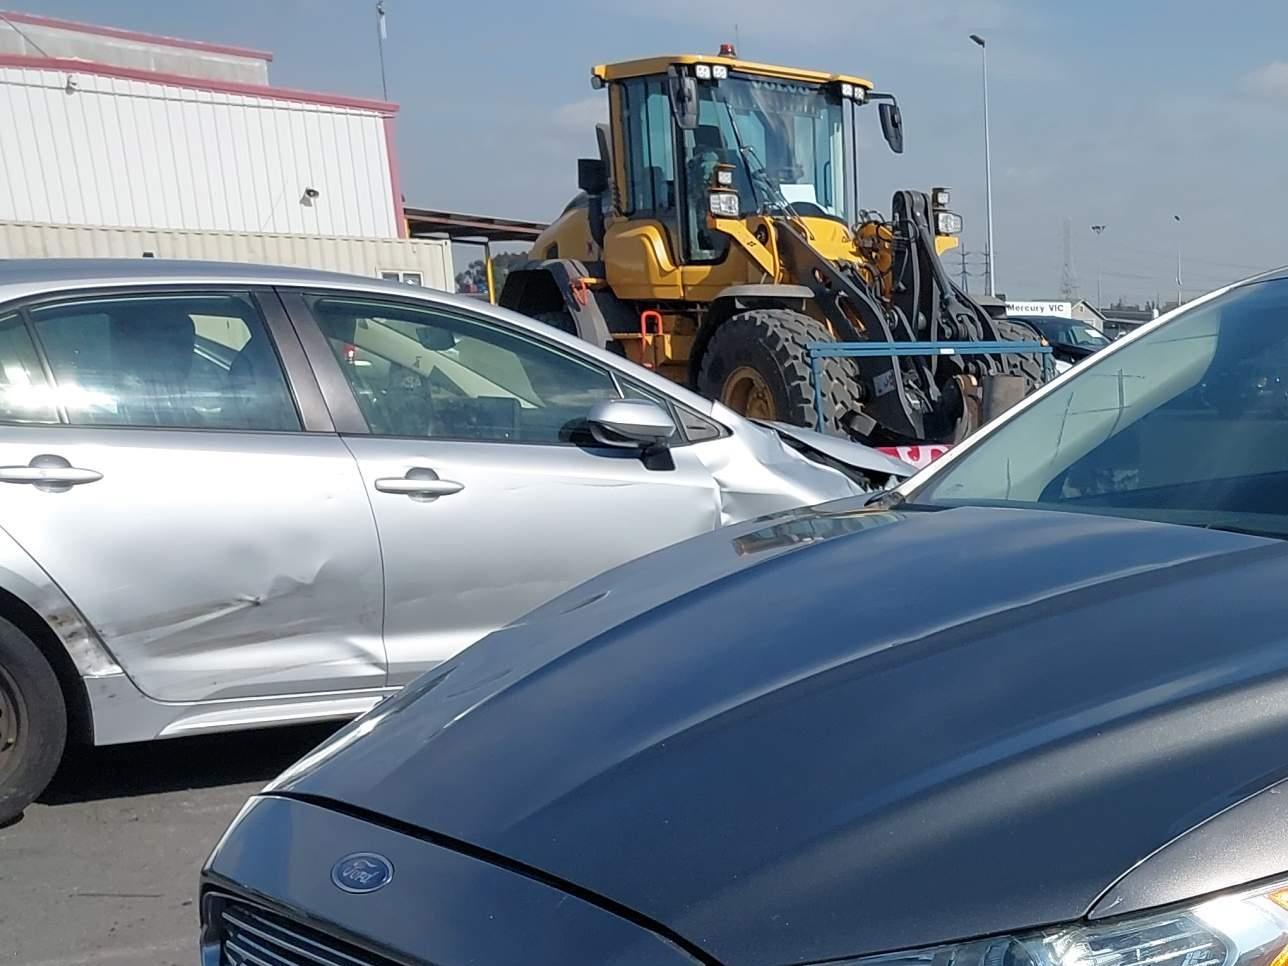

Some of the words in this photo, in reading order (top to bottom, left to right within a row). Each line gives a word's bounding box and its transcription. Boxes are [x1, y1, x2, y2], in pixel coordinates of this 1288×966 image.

[1007, 303, 1045, 313] Mercury
[1048, 303, 1064, 312] VIC
[342, 858, 380, 884] Ford
